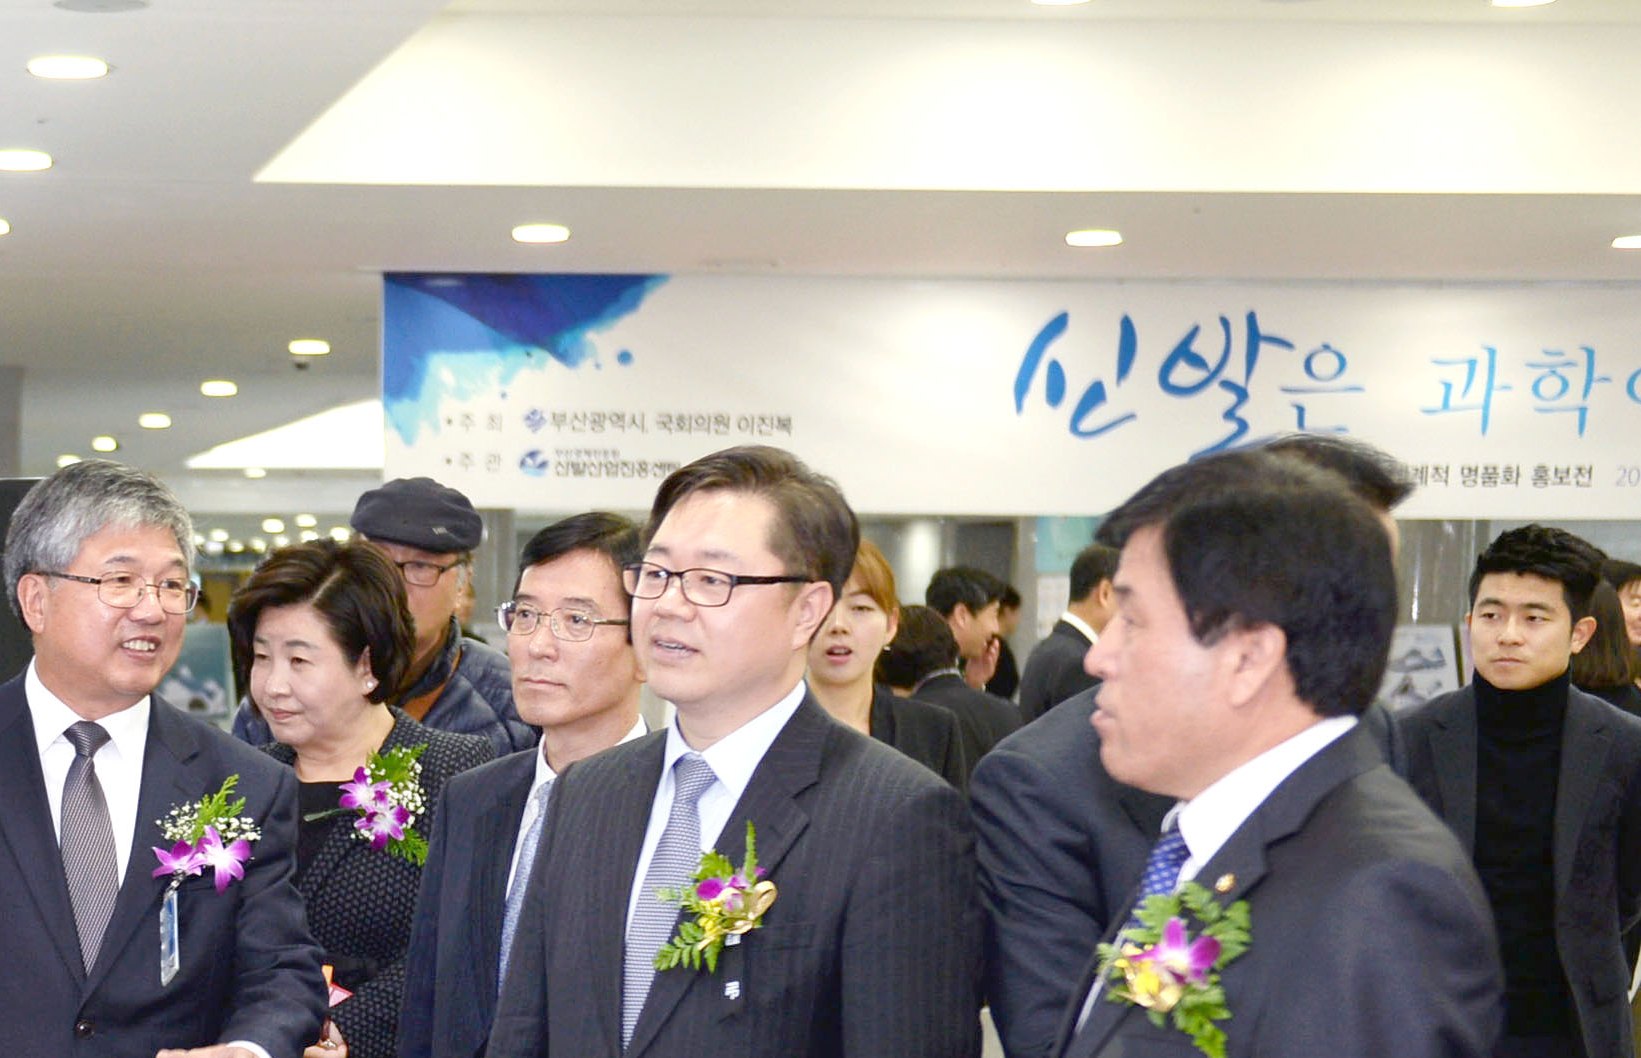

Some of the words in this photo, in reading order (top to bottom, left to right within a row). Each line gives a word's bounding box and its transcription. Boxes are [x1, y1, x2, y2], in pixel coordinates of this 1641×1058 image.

[1013, 310, 1366, 463] 신발은
[1420, 344, 1641, 438] 과학
[1460, 464, 1521, 488] 명품화
[1531, 463, 1593, 489] 홍보전
